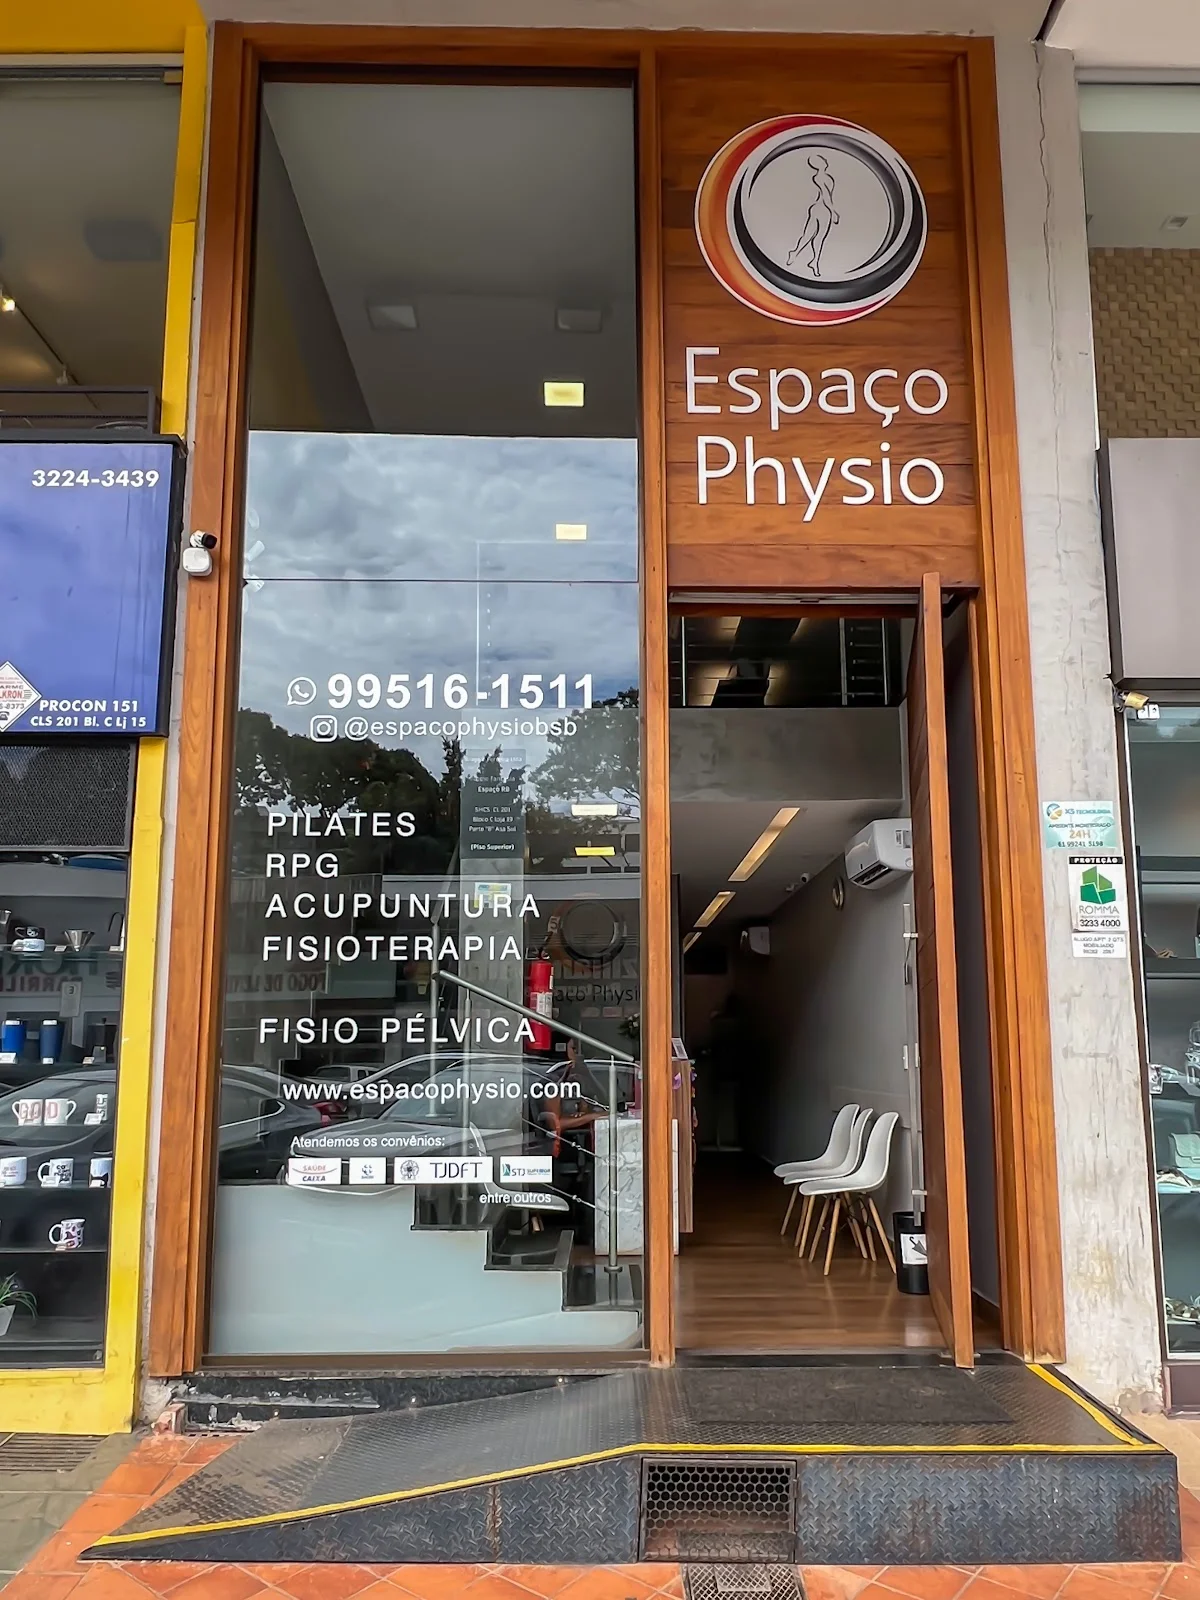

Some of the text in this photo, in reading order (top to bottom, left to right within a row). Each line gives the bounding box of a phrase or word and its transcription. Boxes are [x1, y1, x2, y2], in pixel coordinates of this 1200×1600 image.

[685, 346, 949, 431] Espaço
[31, 469, 160, 488] 3224-3439
[696, 435, 945, 522] Physio
[327, 673, 593, 709] 99516-1511
[39, 700, 138, 713] PROCON 151
[30, 715, 146, 730] CLS 201 Bl. C Lj 15
[344, 716, 578, 742] @espacophysiobsb
[267, 811, 416, 837] PILATES
[266, 852, 339, 878] RPG
[1073, 856, 1118, 865] PROTEÇÃO
[265, 893, 541, 919] ACUPUNTURA
[1079, 905, 1120, 915] ROMMA
[1079, 919, 1121, 927] 3233 4000
[262, 935, 522, 962] FISIOTERAPIA
[592, 984, 638, 1005] Physi
[259, 1012, 537, 1044] FISIO PÉLVICA
[282, 1078, 582, 1104] www.espacophysio.com
[291, 1135, 446, 1148] Atendemos os convênios:
[430, 1162, 483, 1178] TJDFT
[511, 1168, 526, 1177] STJ
[479, 1193, 552, 1204] entre outros
